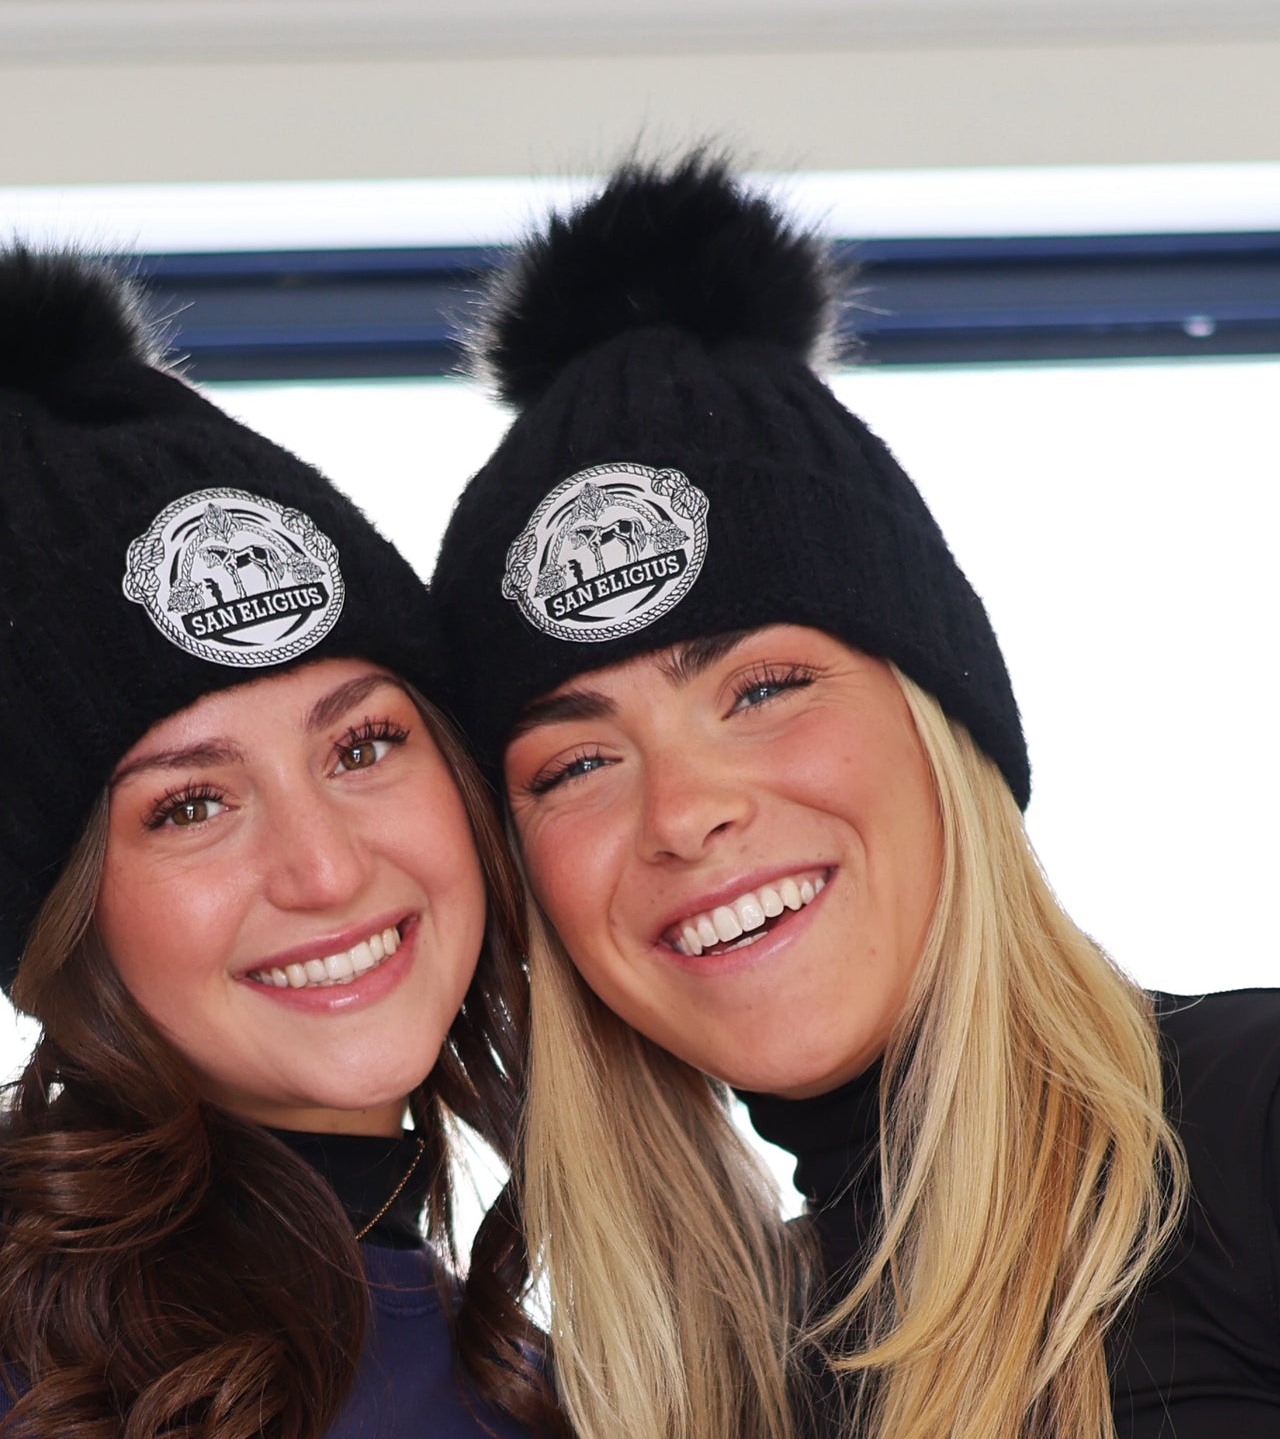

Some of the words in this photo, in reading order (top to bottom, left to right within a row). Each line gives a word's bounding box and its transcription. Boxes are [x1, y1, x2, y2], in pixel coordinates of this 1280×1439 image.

[191, 606, 238, 636] SAN
[237, 587, 323, 622] ELIGIUS
[552, 583, 593, 617] SAN
[596, 555, 680, 598] ELIGIUS
